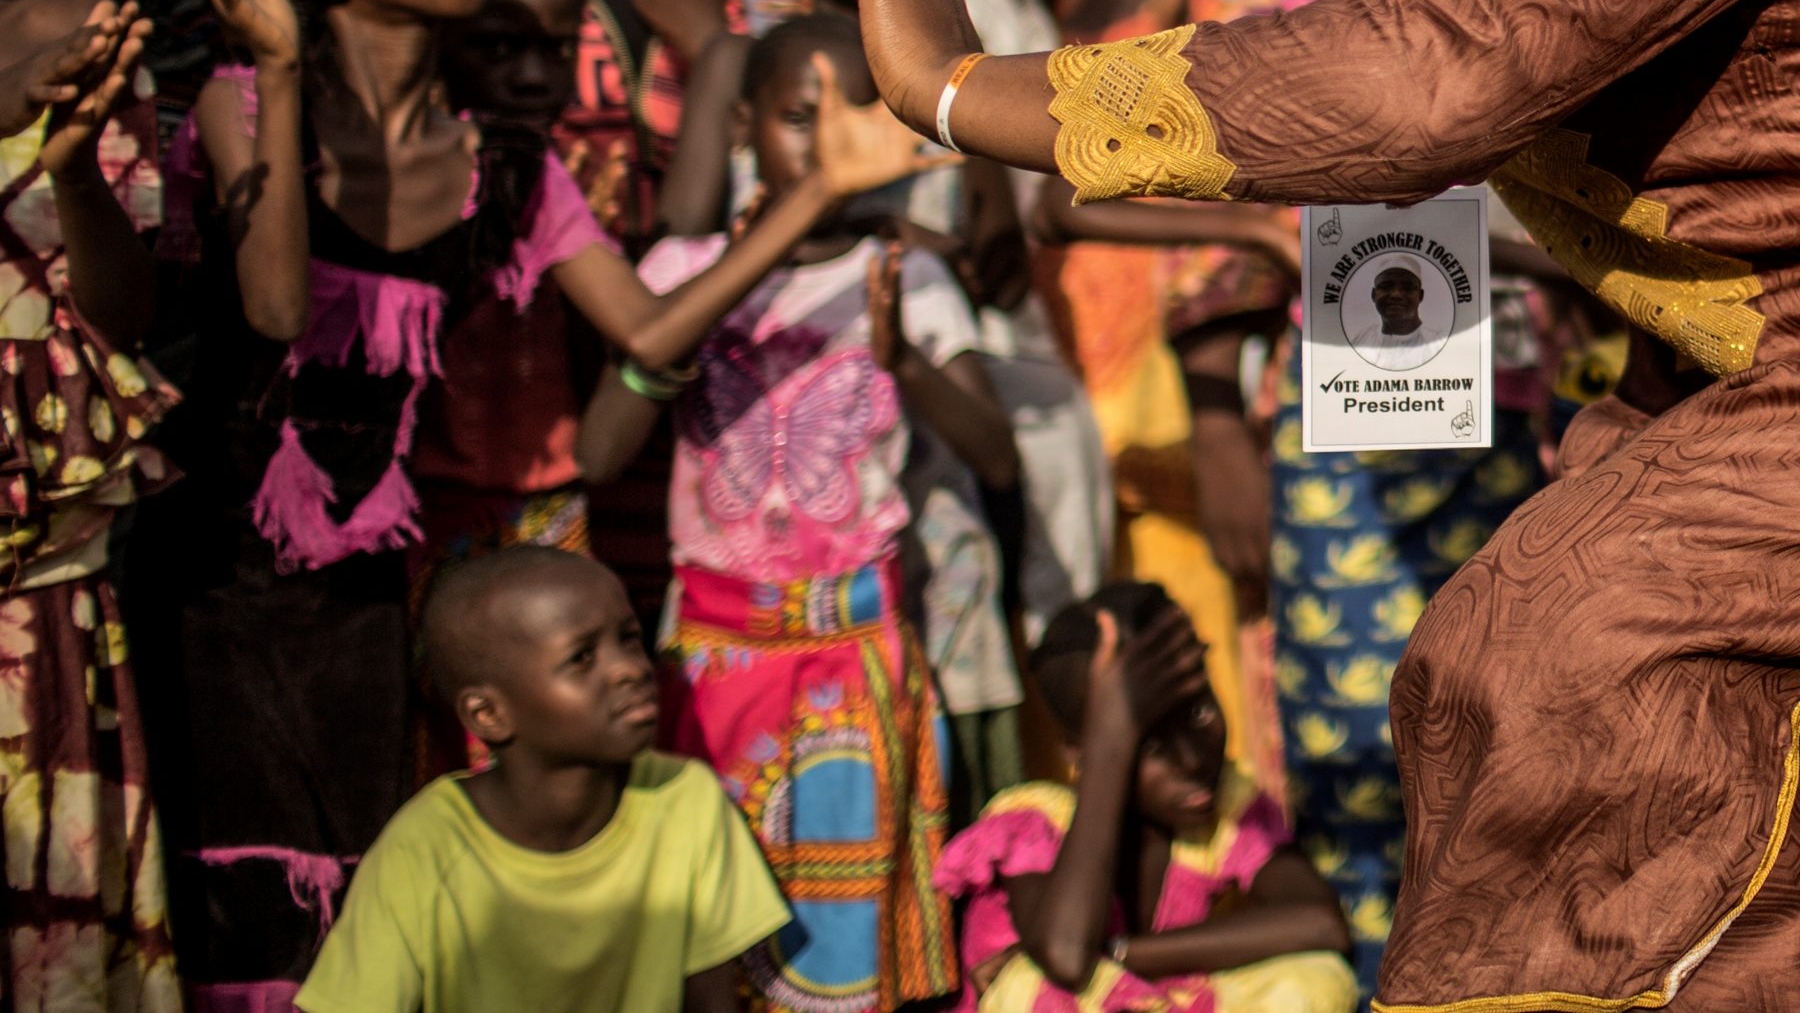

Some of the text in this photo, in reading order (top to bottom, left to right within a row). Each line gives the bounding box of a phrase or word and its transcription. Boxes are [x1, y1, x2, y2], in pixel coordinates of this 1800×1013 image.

[1323, 232, 1473, 304] WE ARE STRONGER TOGETHER
[1364, 379, 1410, 393] ADAMA
[1413, 378, 1474, 392] BARROW
[1344, 397, 1445, 414] President
